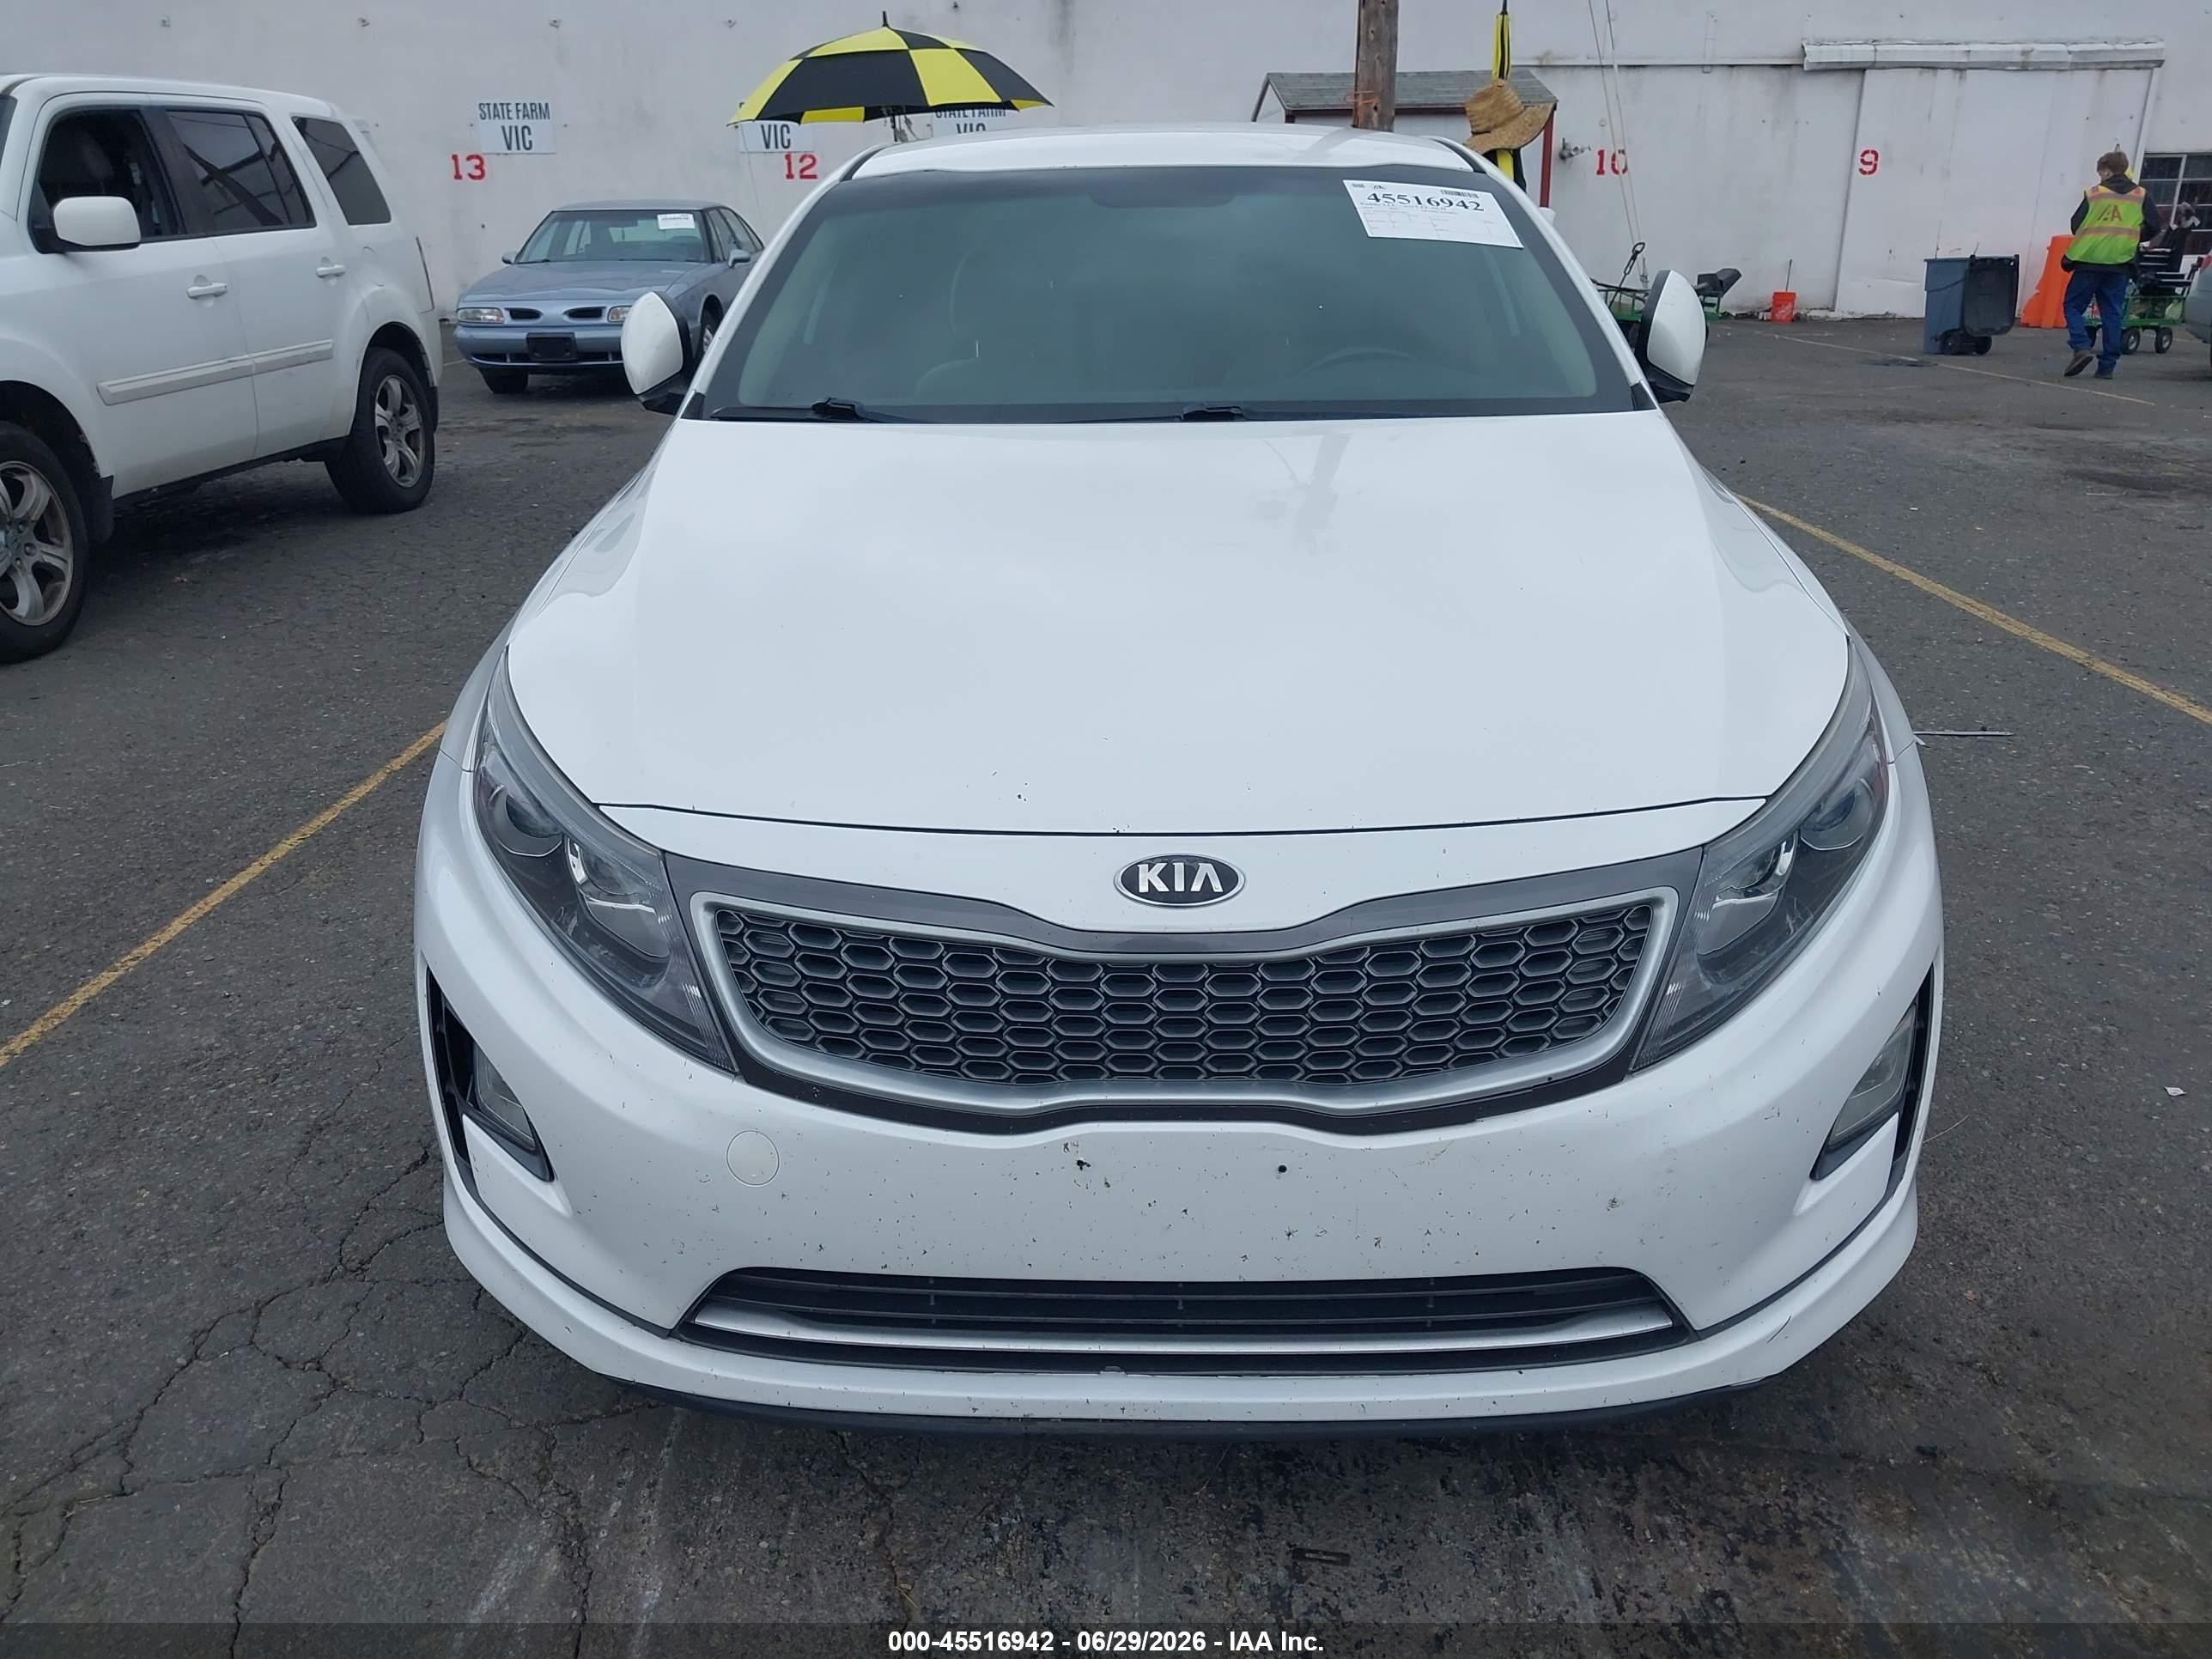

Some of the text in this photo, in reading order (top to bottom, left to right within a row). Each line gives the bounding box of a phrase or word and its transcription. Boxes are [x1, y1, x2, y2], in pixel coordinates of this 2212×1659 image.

[478, 102, 550, 120] STATE FARM
[501, 125, 533, 151] VIC
[760, 124, 791, 149] VIC
[452, 154, 486, 180] 13
[785, 153, 817, 179] 12
[1596, 149, 1628, 175] 10
[1858, 149, 1879, 175] 9
[1367, 192, 1485, 212] 45516942
[1138, 862, 1224, 893] KIA
